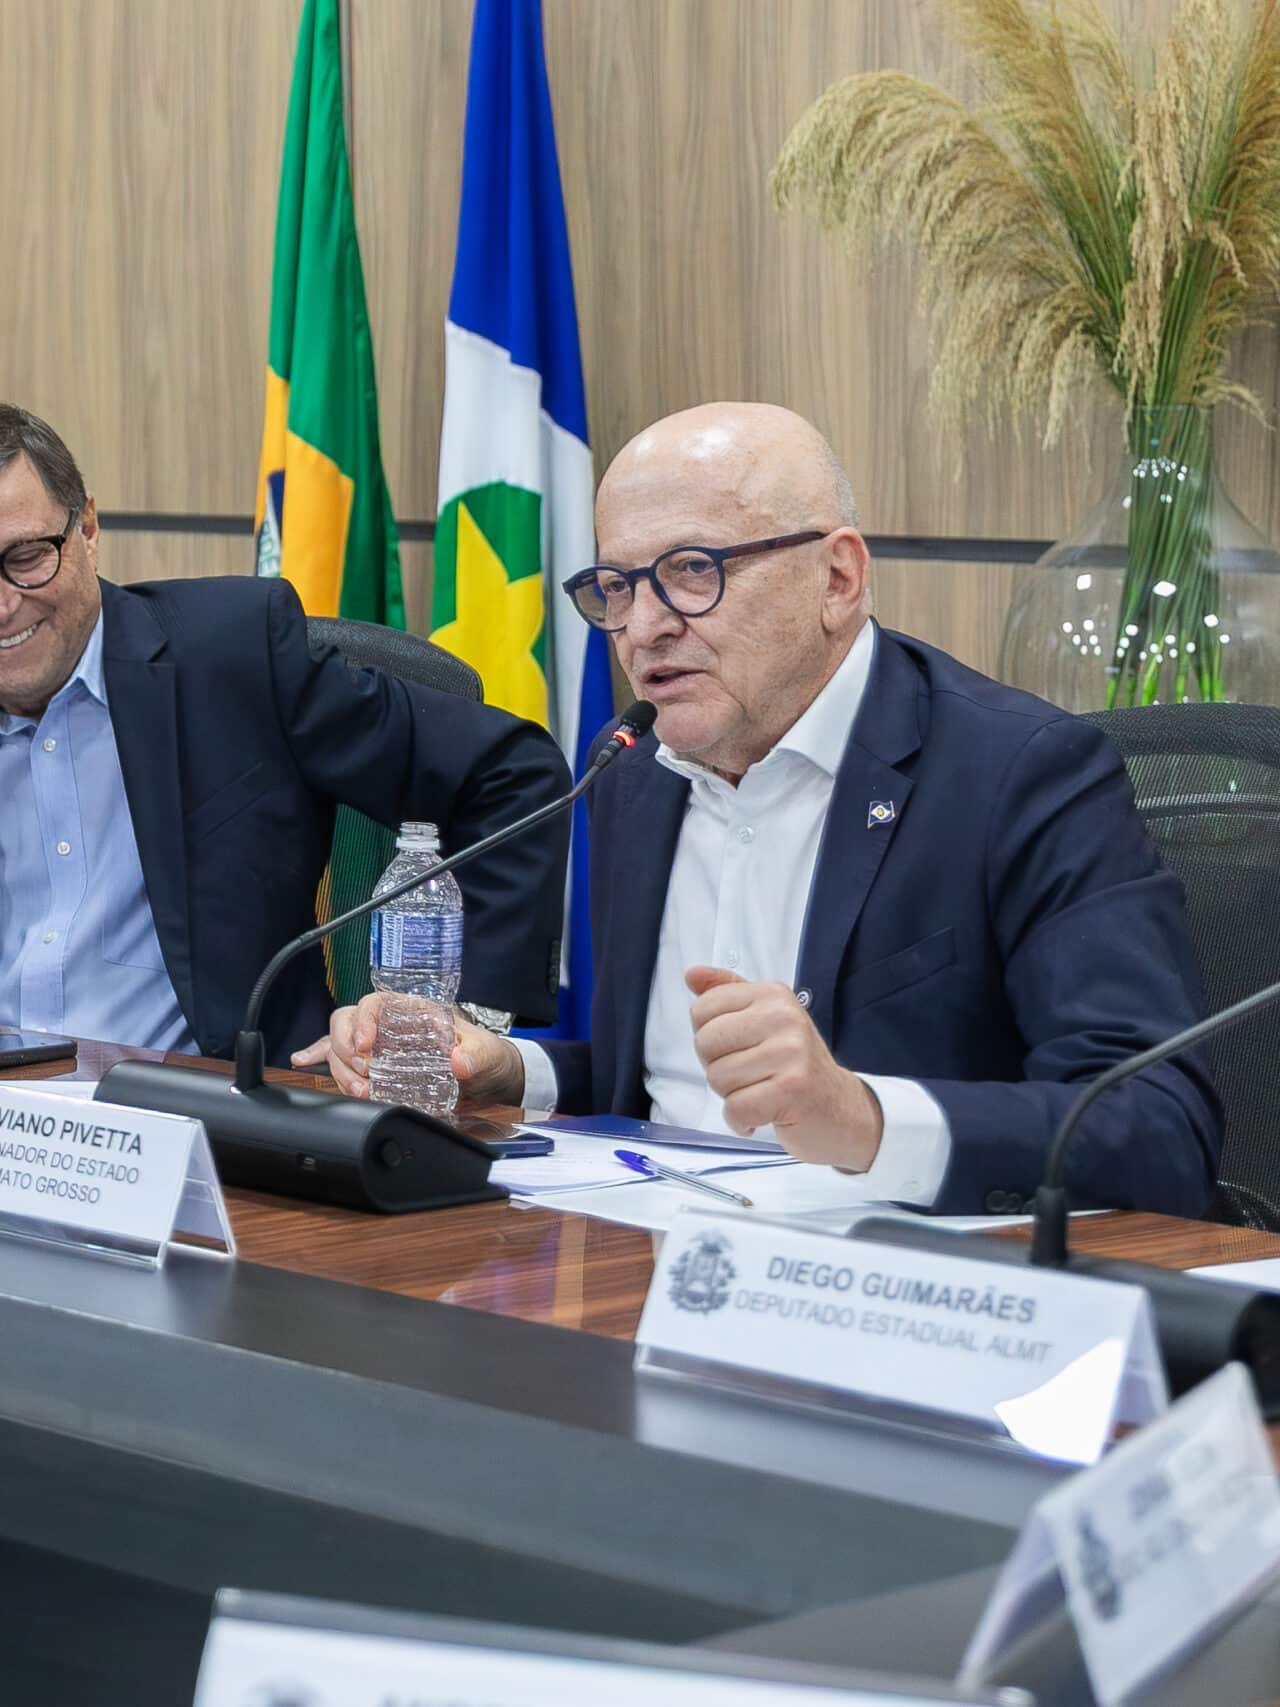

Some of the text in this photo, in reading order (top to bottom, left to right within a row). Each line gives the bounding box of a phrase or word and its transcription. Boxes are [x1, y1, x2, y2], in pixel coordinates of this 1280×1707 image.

[60, 1120, 141, 1155] PIVETTA
[50, 1152, 73, 1170] DO
[76, 1157, 139, 1184] ESTADO
[36, 1176, 100, 1204] GROSSO
[767, 1257, 1036, 1324] DIEGO GUIMARÃES
[734, 1289, 1053, 1364] DEPUTADO ESTADUAL ALMT
